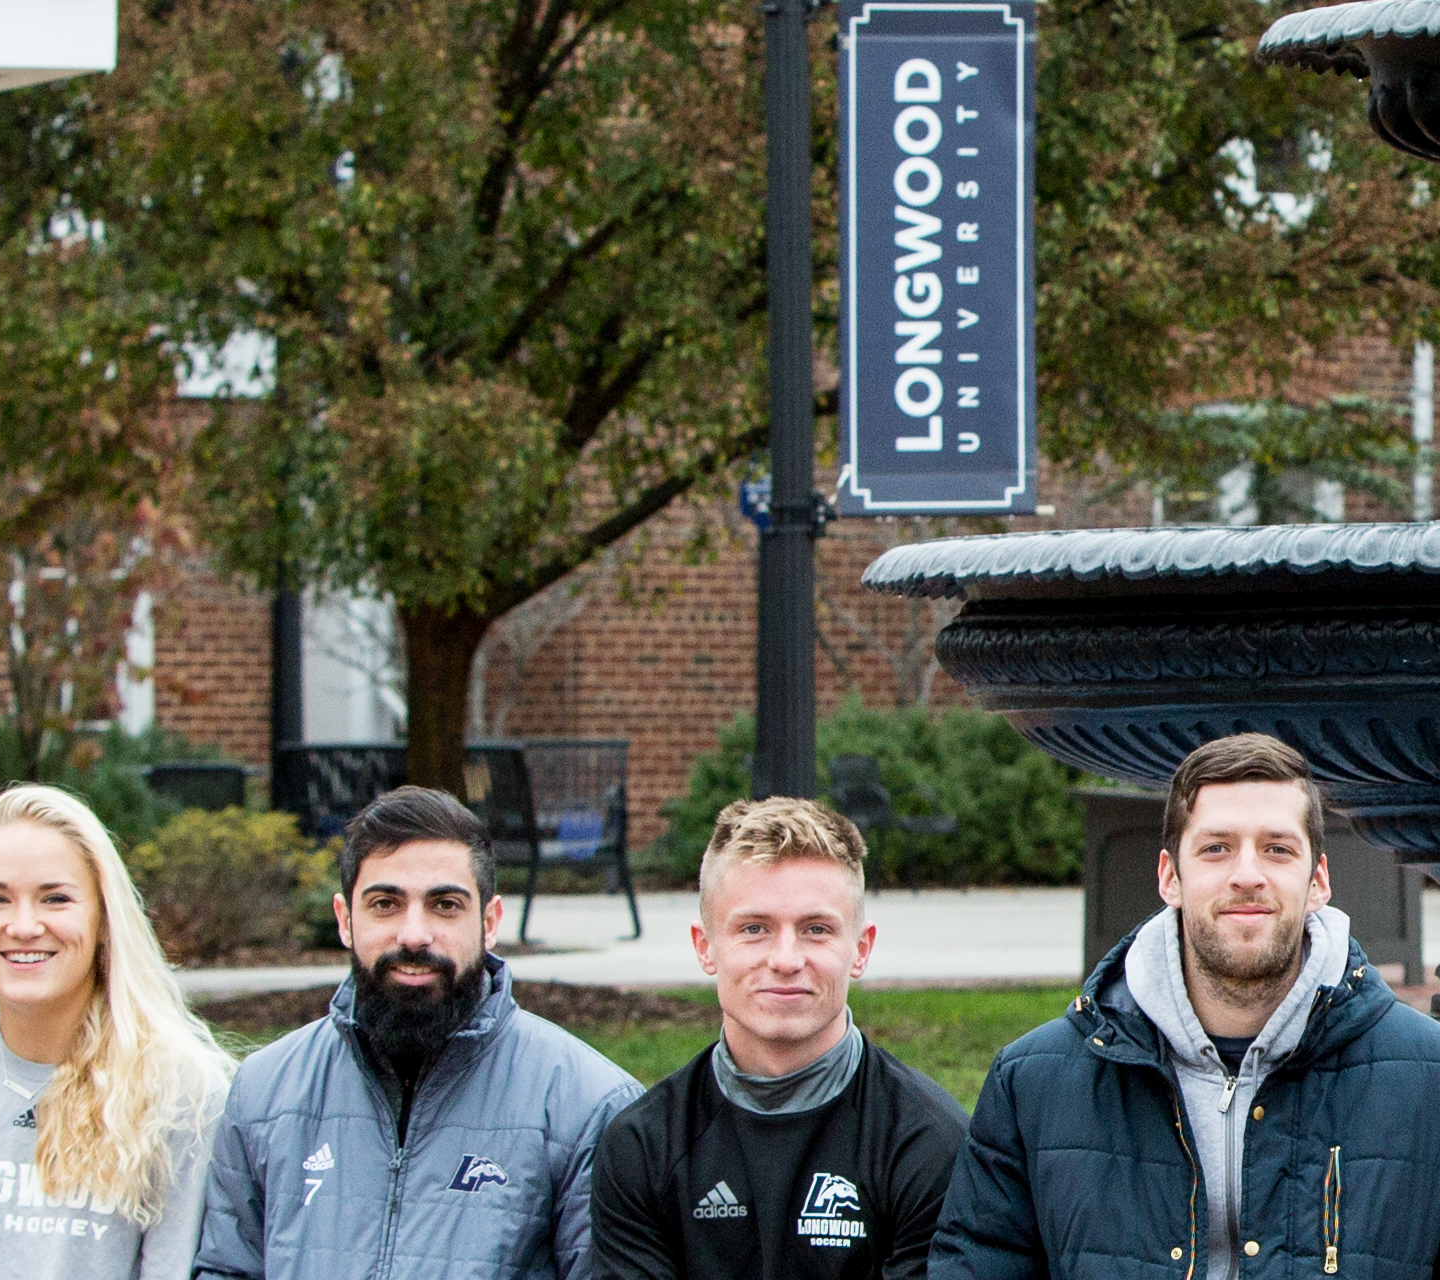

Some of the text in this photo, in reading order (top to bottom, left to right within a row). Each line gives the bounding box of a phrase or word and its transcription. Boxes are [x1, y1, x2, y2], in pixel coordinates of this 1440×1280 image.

[894, 57, 943, 453] LONGWOOD
[956, 61, 982, 454] UNIVERSITY
[304, 1178, 323, 1206] 7
[693, 1203, 747, 1219] adidas
[4, 1213, 109, 1240] HOCKEY
[810, 1238, 851, 1248] SOCCER
